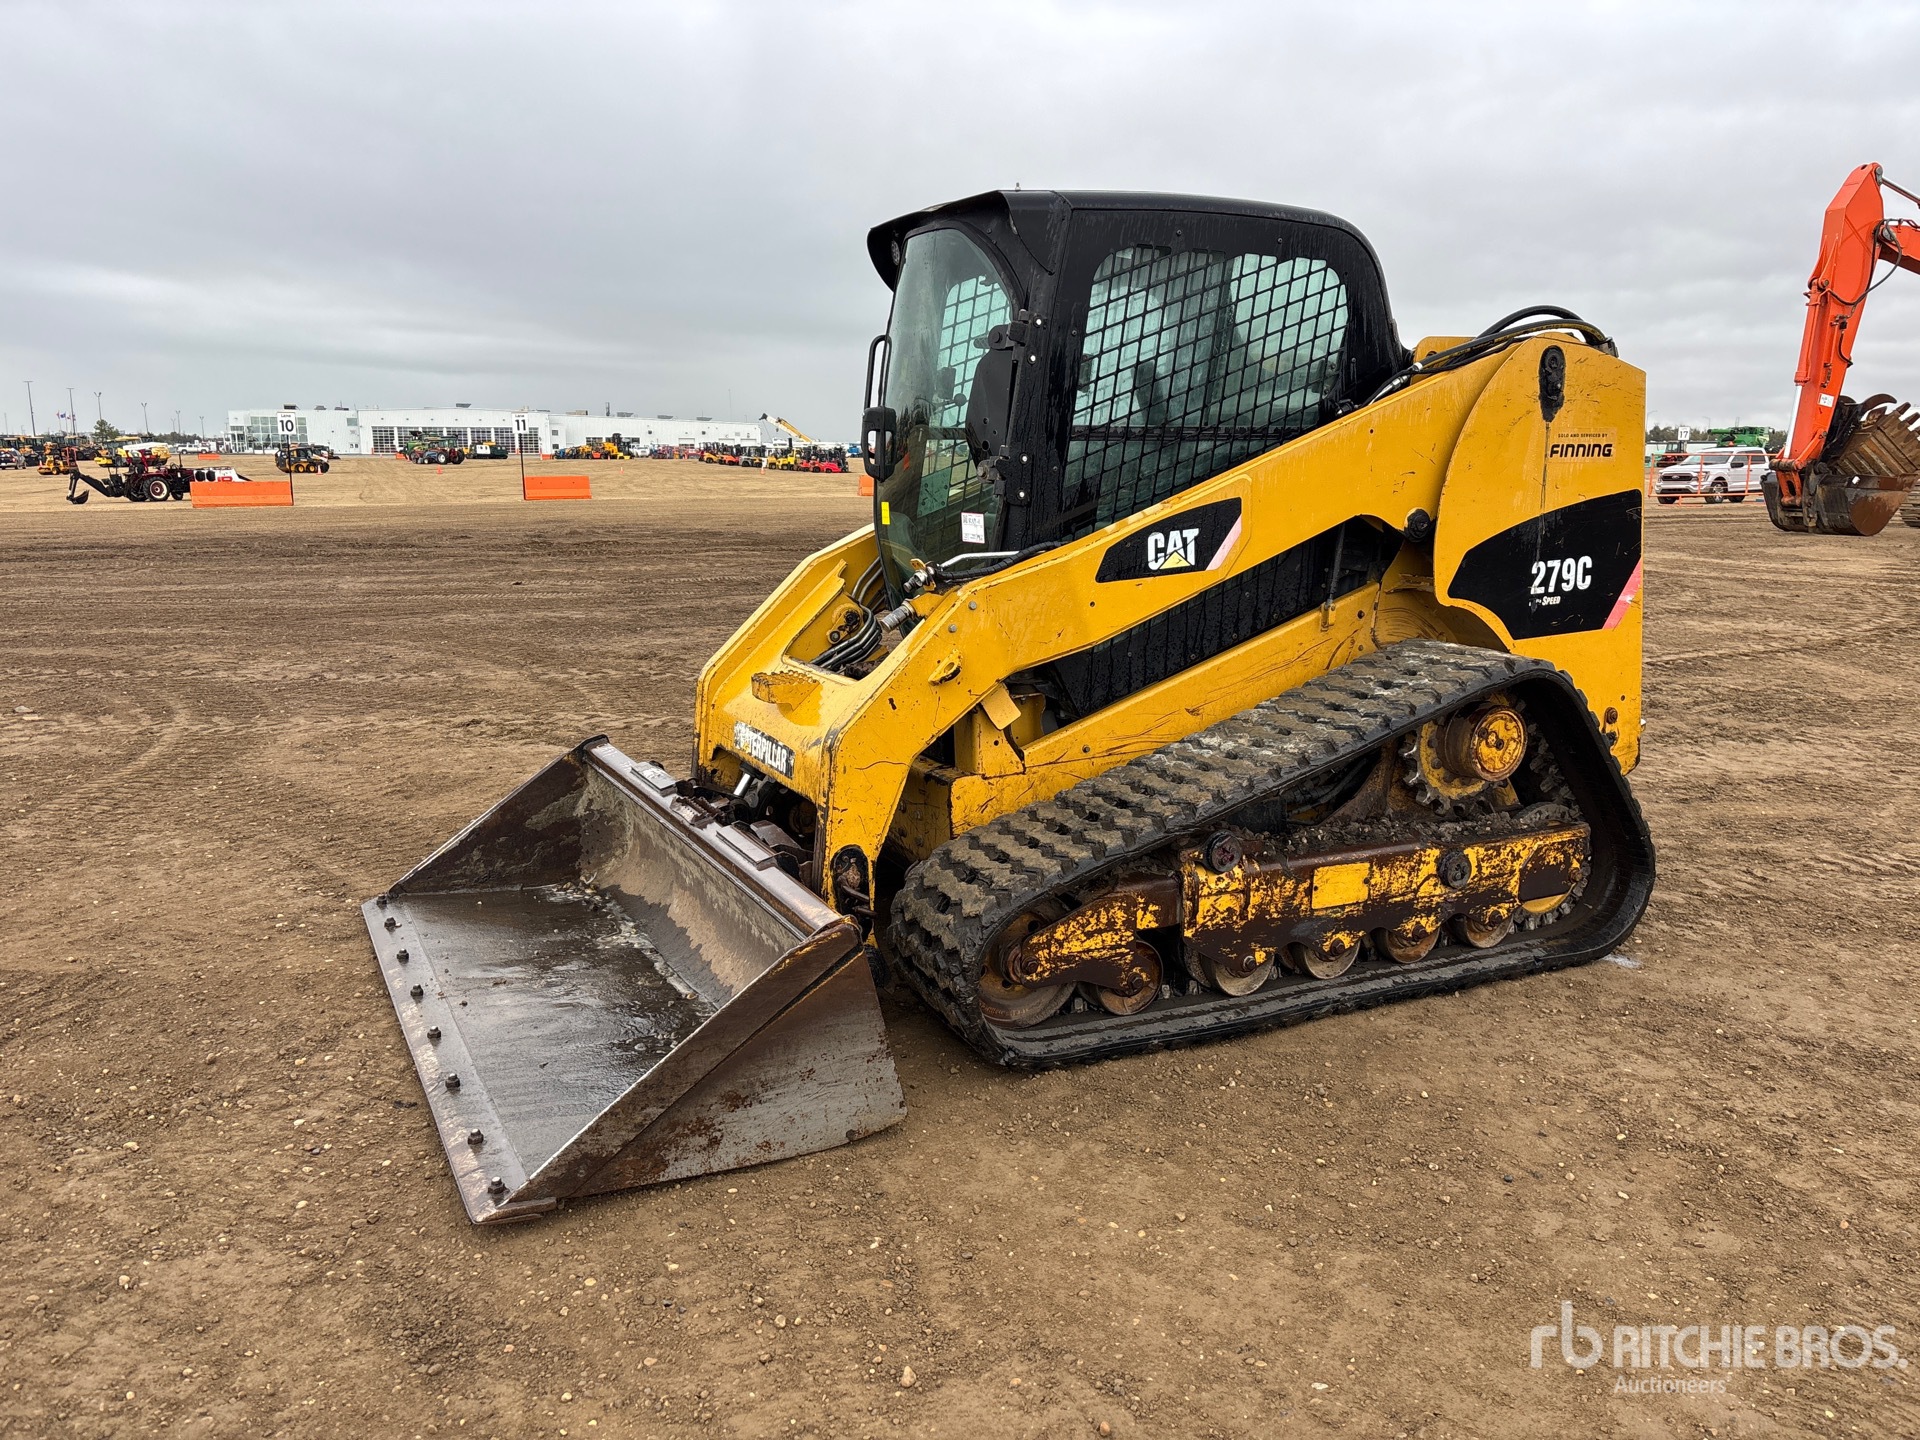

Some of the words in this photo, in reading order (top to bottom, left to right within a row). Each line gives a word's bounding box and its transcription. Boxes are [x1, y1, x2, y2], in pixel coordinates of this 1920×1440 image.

[279, 420, 294, 432] 10
[515, 419, 526, 431] 11
[1550, 443, 1613, 457] FINNING
[1148, 528, 1199, 570] CAT
[1530, 555, 1593, 595] 279C
